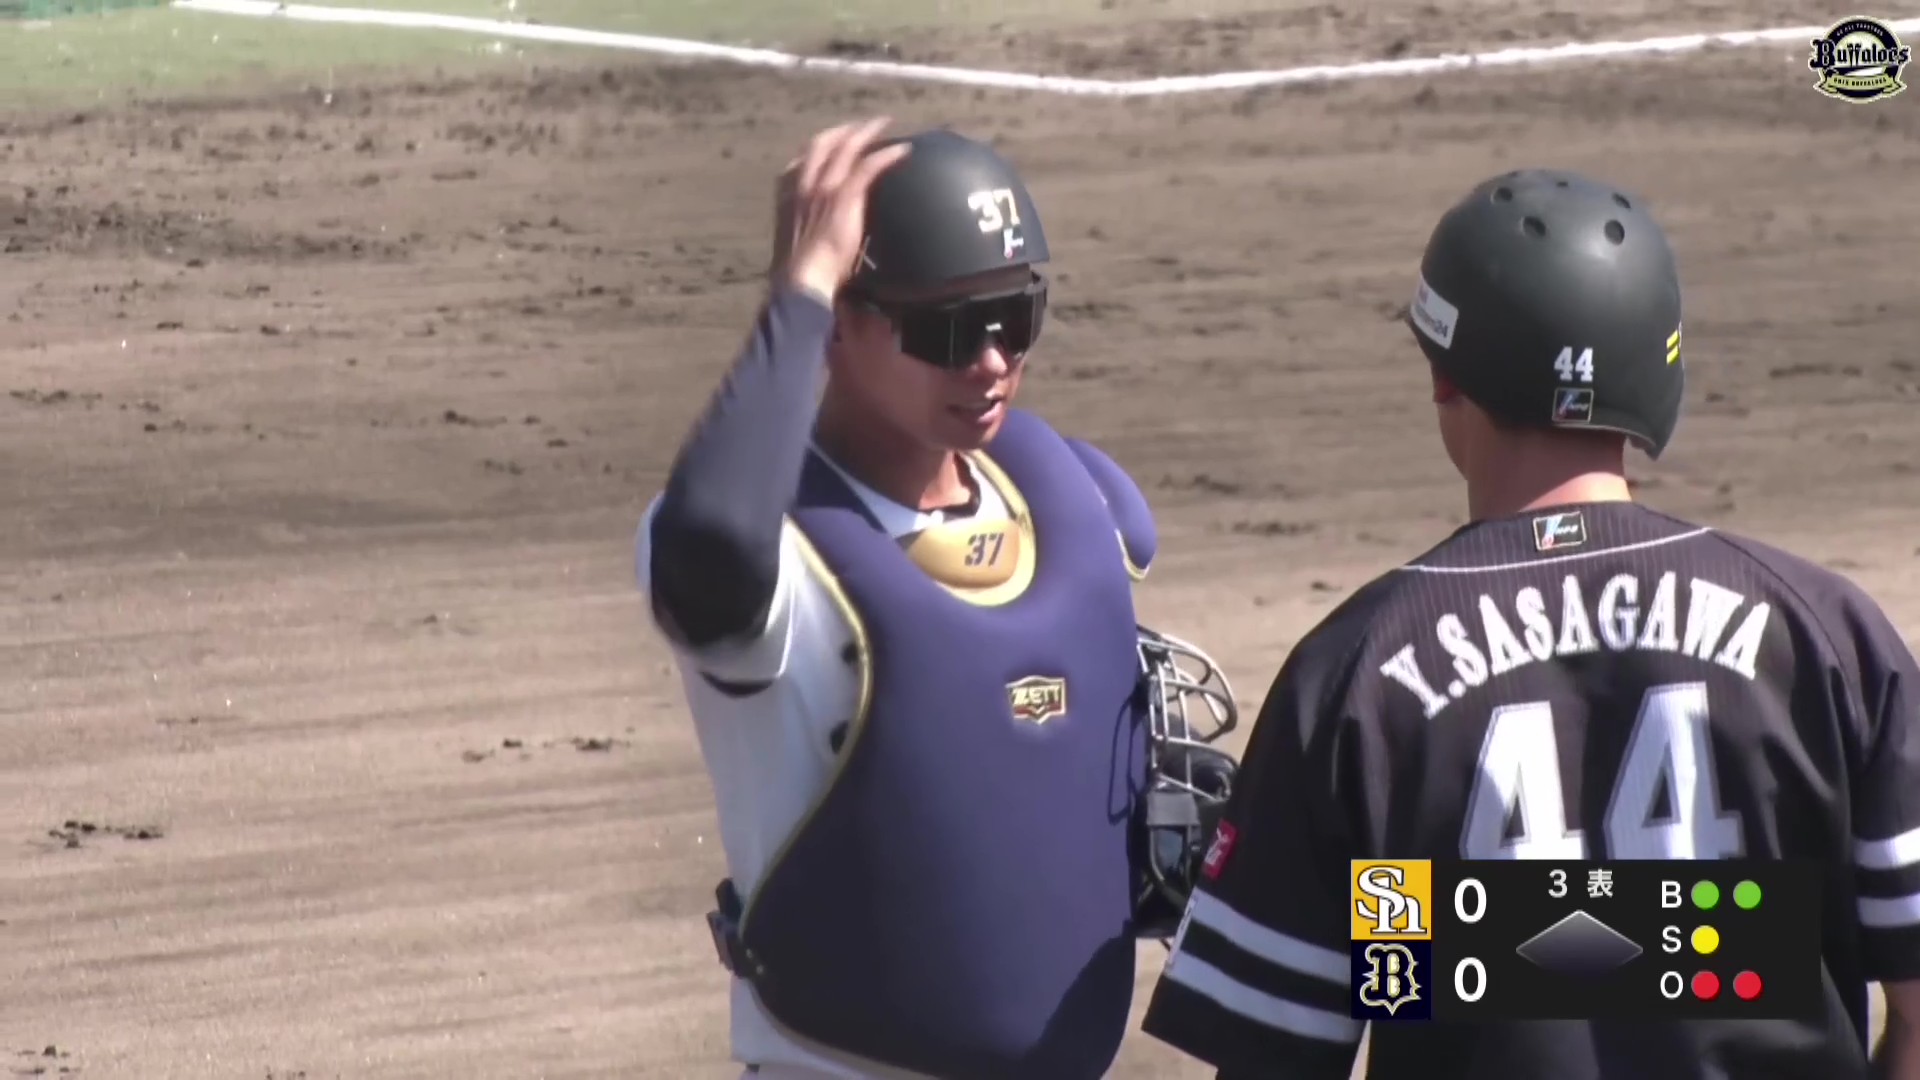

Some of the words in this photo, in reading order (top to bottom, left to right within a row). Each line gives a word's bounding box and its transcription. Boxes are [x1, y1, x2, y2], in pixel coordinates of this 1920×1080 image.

[968, 188, 1021, 233] 37
[1554, 346, 1594, 382] 44
[964, 532, 1005, 567] 37
[1380, 571, 1770, 719] Y.SASAGAWA
[1012, 685, 1061, 705] ZETT
[1458, 681, 1746, 860] 44
